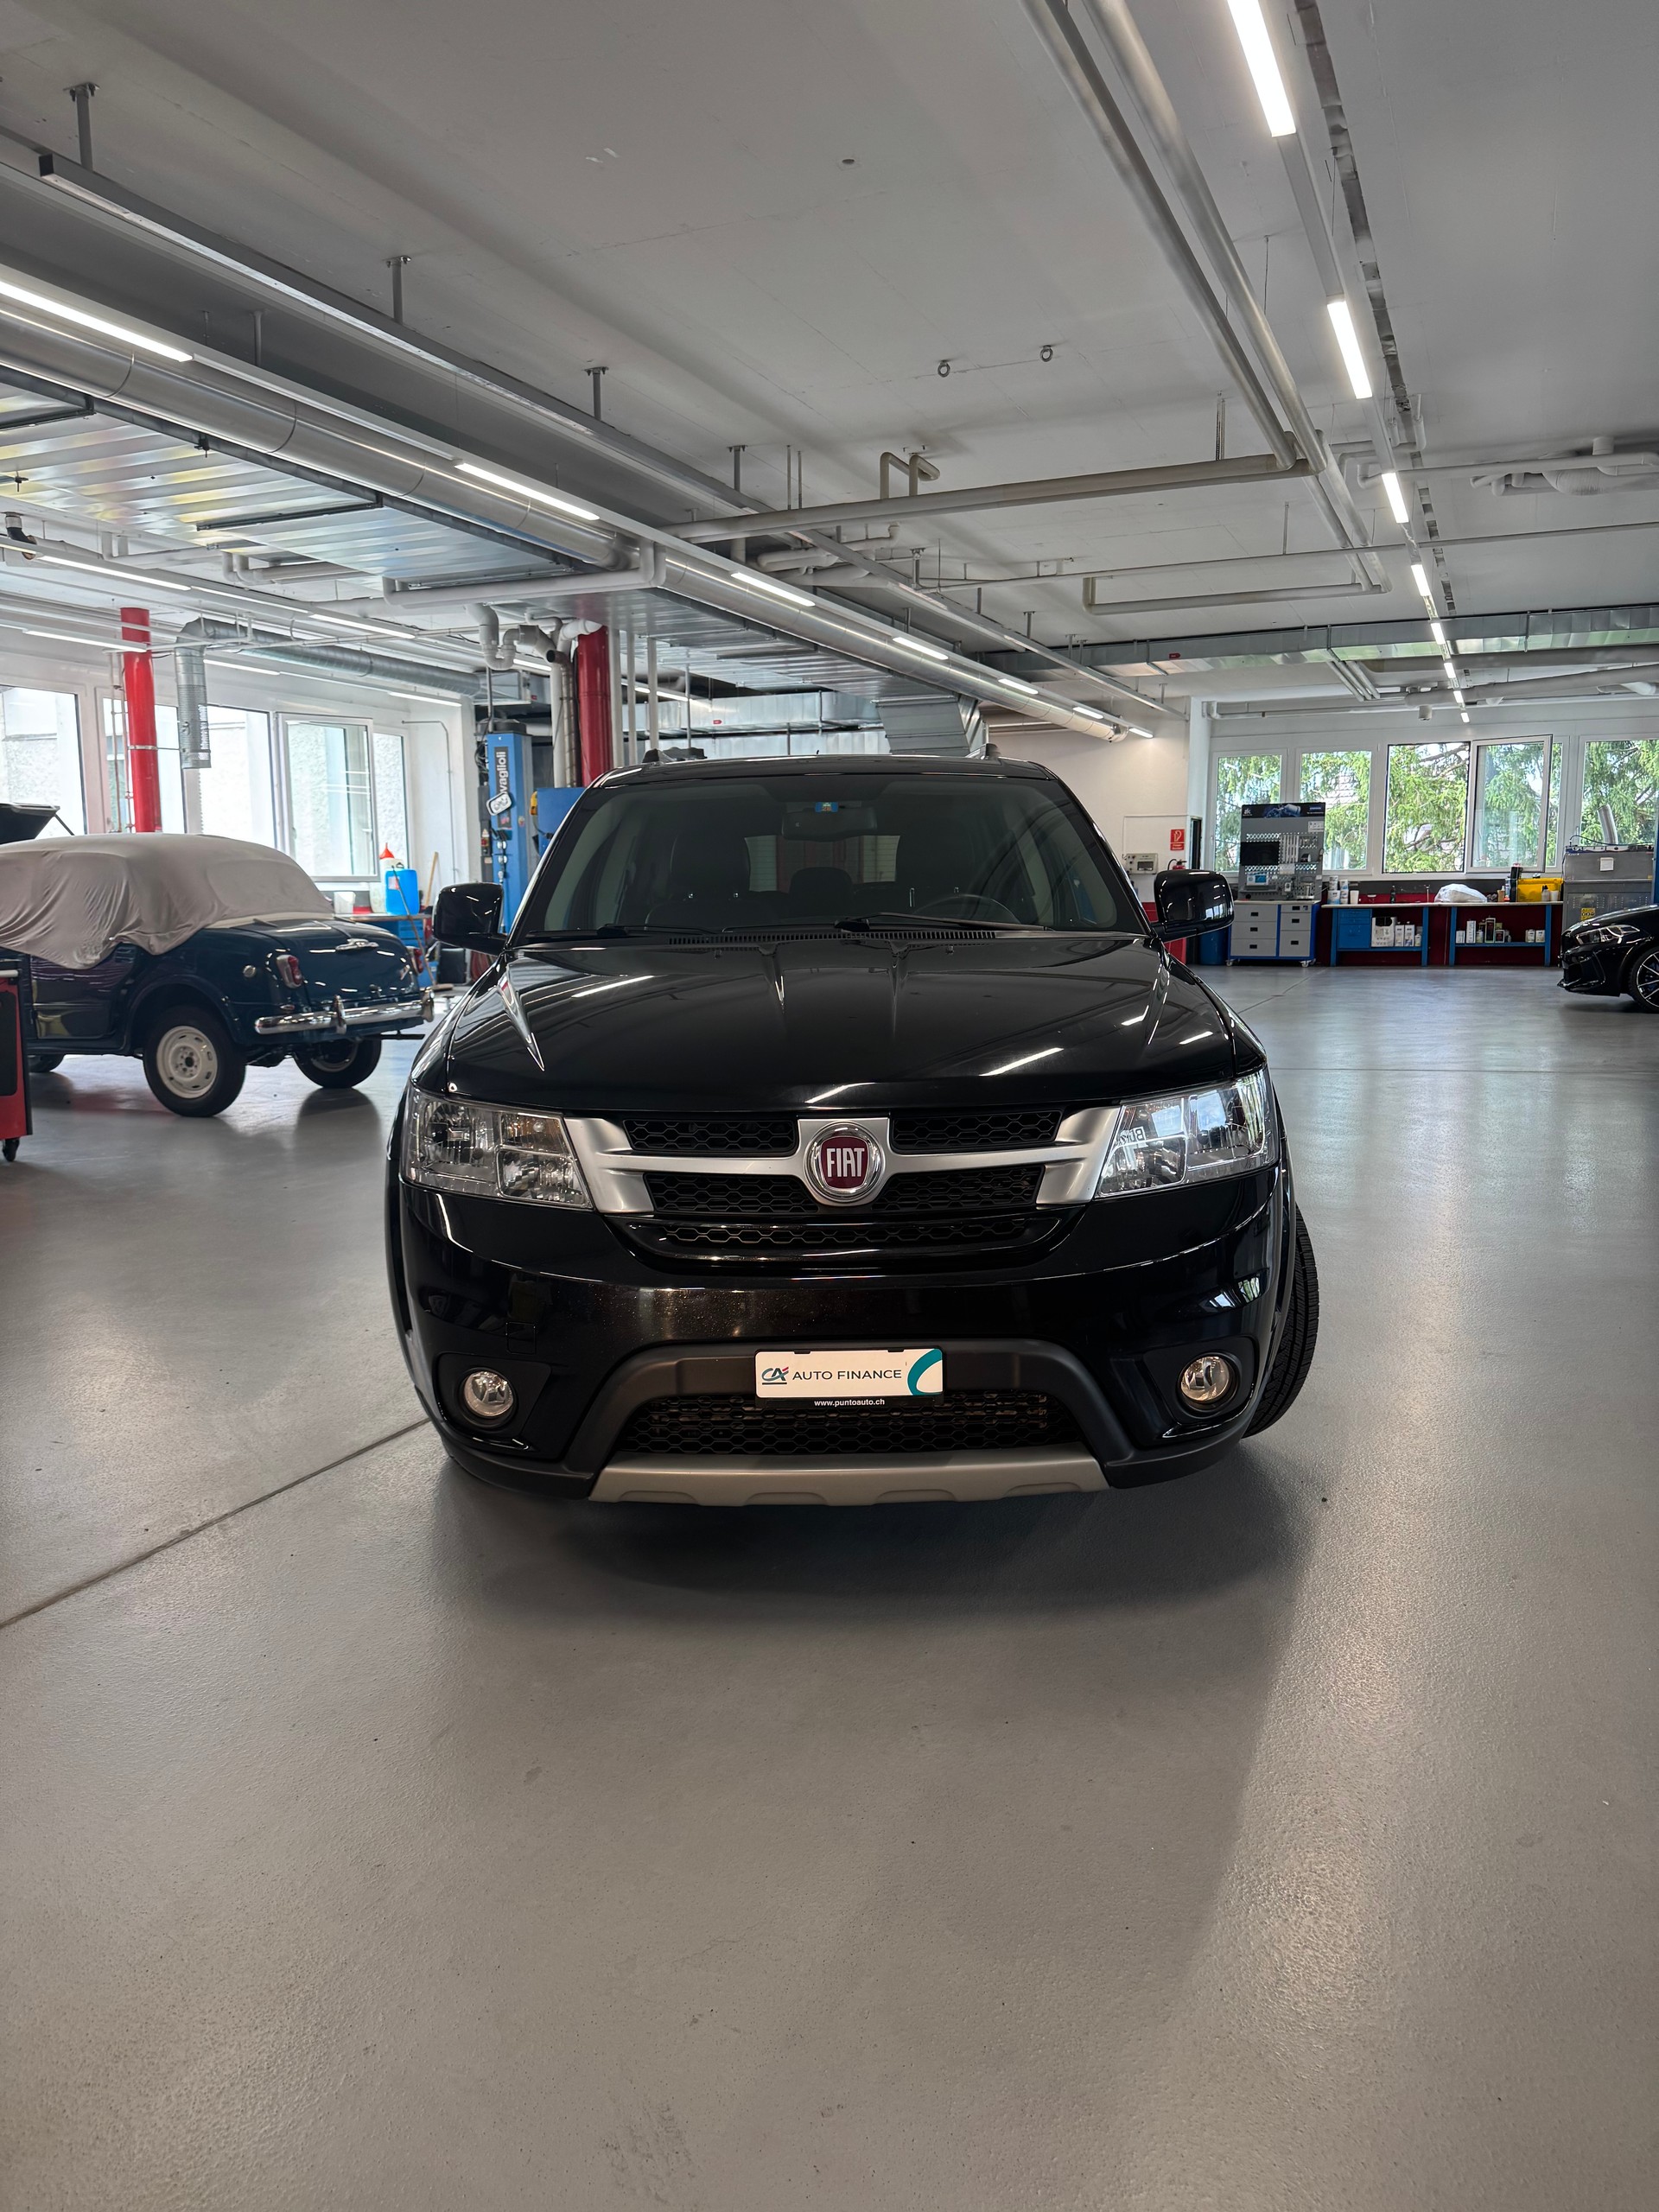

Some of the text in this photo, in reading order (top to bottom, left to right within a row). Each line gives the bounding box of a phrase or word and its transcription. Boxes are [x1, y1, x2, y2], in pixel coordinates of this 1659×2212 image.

[495, 751, 509, 794] vaglioli
[826, 1147, 865, 1178] FIAT
[792, 1370, 833, 1381] AUTO
[837, 1370, 902, 1380] FINANCE
[814, 1398, 885, 1408] www.puntoauto.ch
